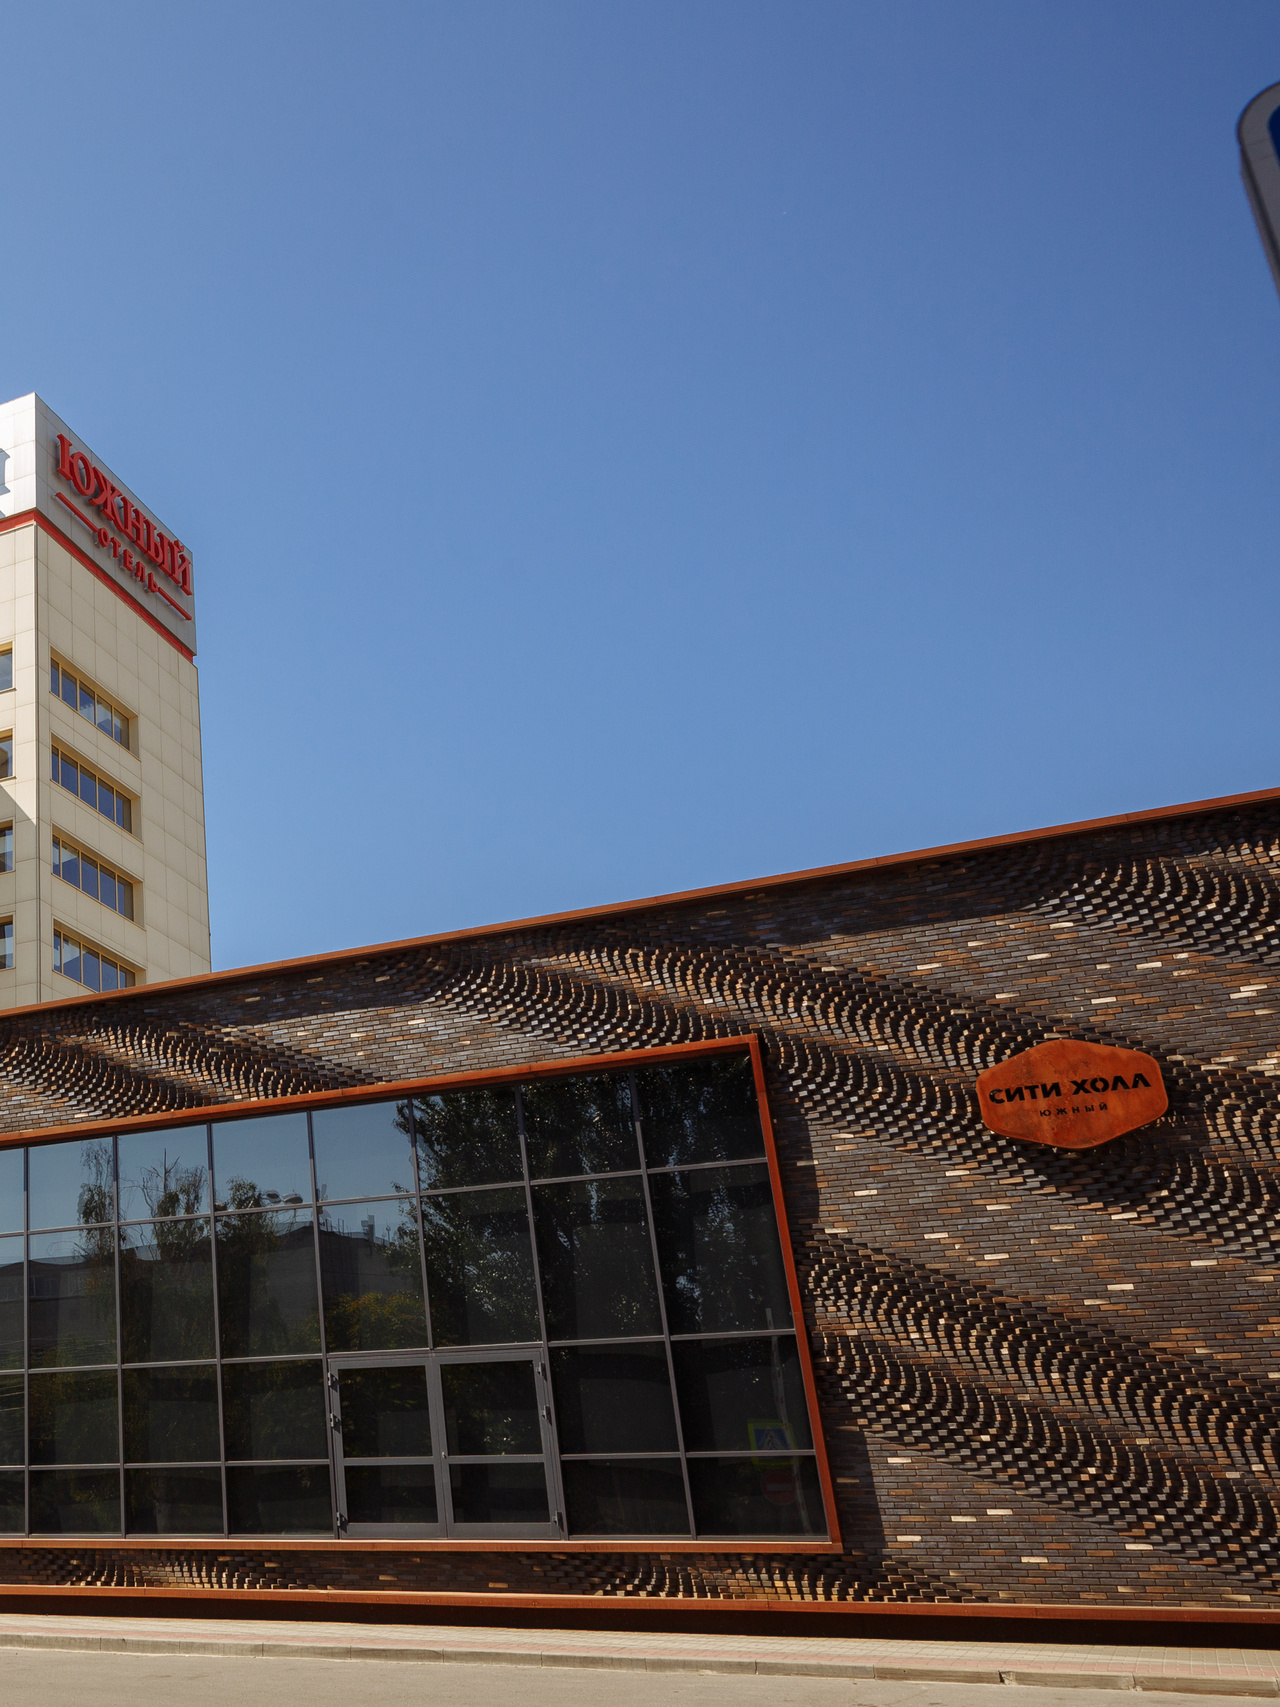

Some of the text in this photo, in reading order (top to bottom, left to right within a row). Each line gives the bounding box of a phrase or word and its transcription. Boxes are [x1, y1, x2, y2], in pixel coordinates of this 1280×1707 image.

[57, 433, 192, 596] ЮЖНЫЙ
[98, 527, 158, 593] ОТЕЛЬ
[989, 1073, 1151, 1105] СИТИ ХОЛЛ
[1039, 1102, 1108, 1117] ЮЖНЫЙ
